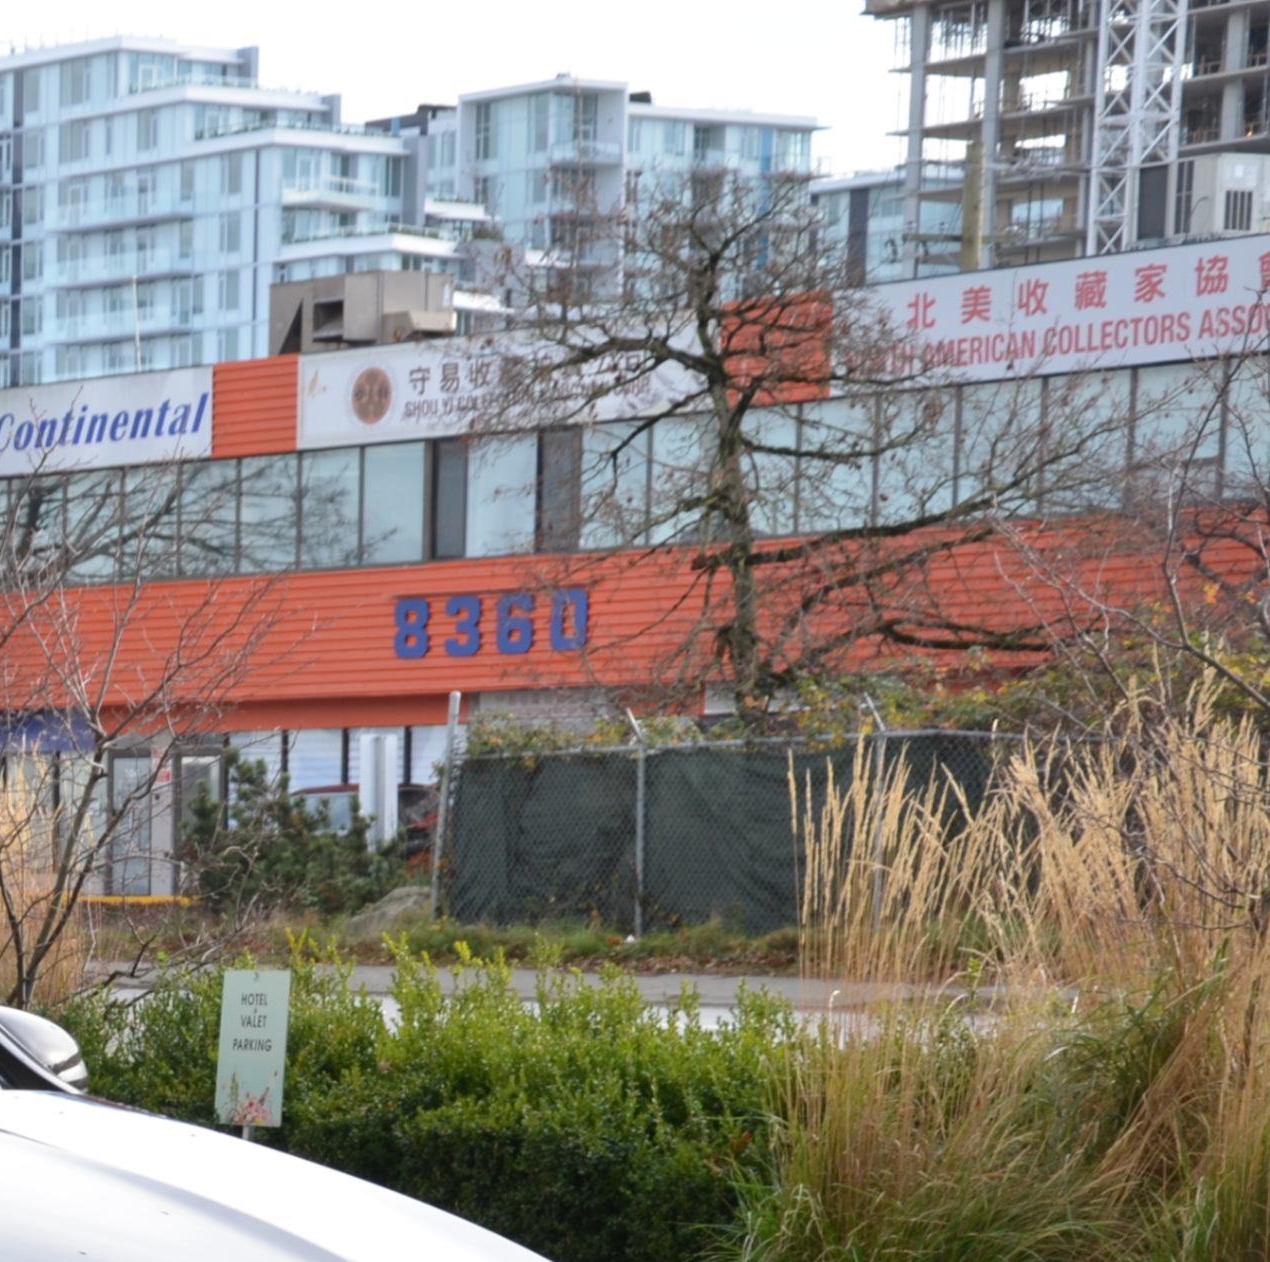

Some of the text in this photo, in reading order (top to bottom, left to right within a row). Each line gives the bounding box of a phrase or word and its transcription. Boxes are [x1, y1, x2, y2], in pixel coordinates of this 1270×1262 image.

[1043, 312, 1191, 358] COLLECTORS
[393, 587, 589, 659] 8360
[241, 993, 268, 1006] HOTEL
[241, 1015, 267, 1028] VALET
[233, 1038, 272, 1052] PARKING
